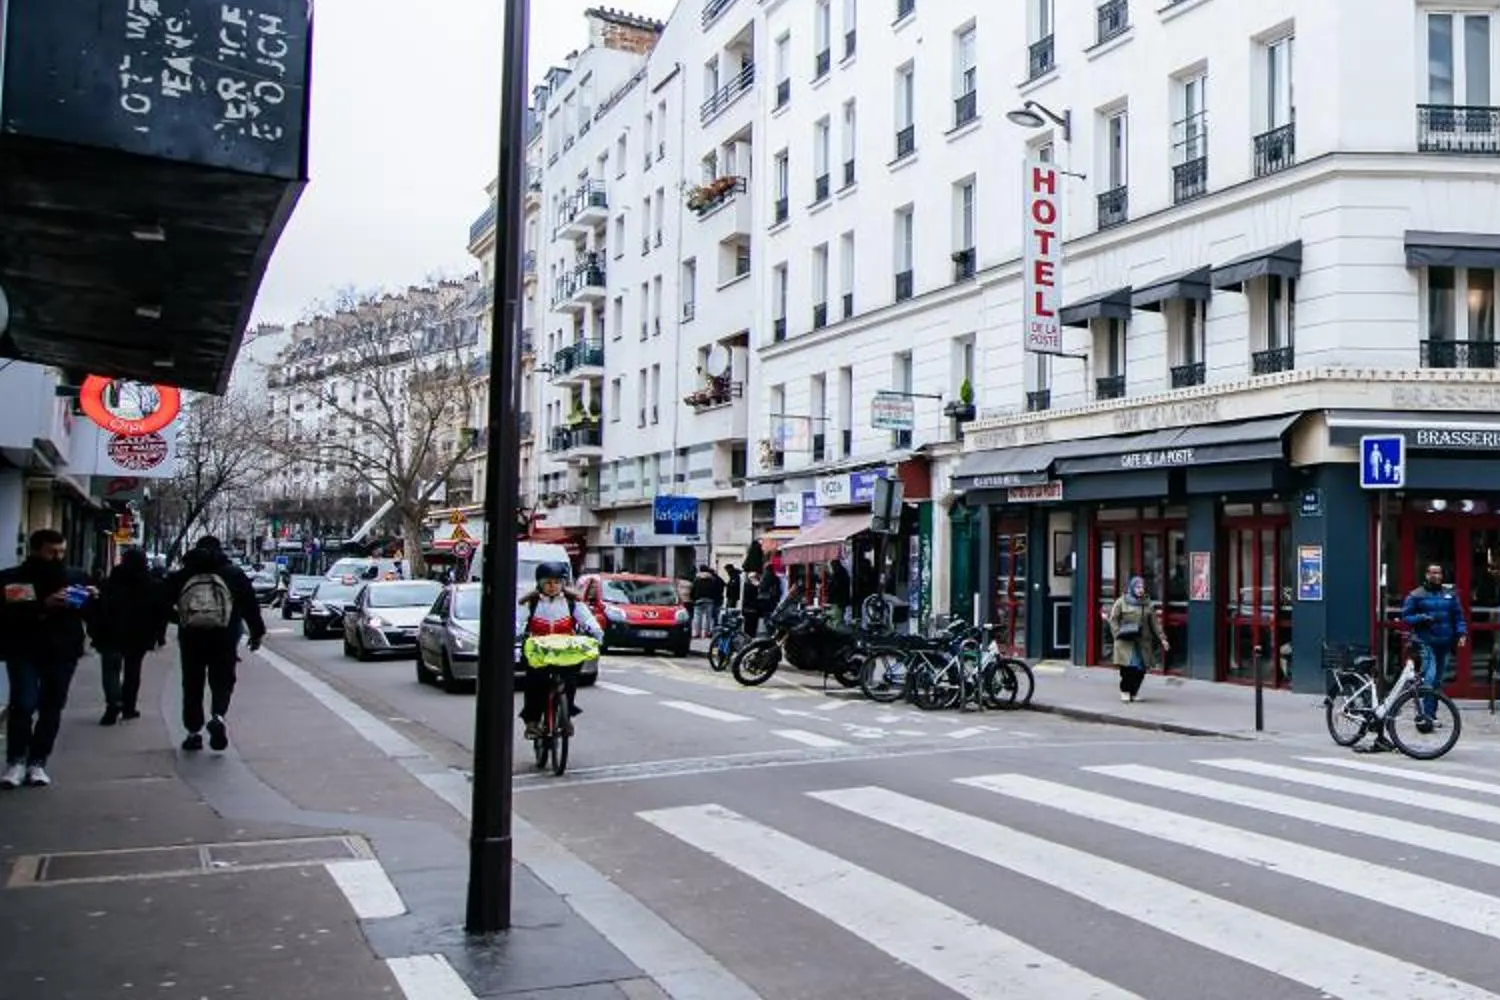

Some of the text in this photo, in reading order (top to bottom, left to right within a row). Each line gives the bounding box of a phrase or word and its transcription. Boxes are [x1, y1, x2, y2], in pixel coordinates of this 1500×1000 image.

[1032, 167, 1056, 318] HOTEL
[1031, 322, 1057, 335] DE LA
[1030, 333, 1058, 347] POSTE
[1121, 448, 1195, 468] CAFE DE LA POSTE
